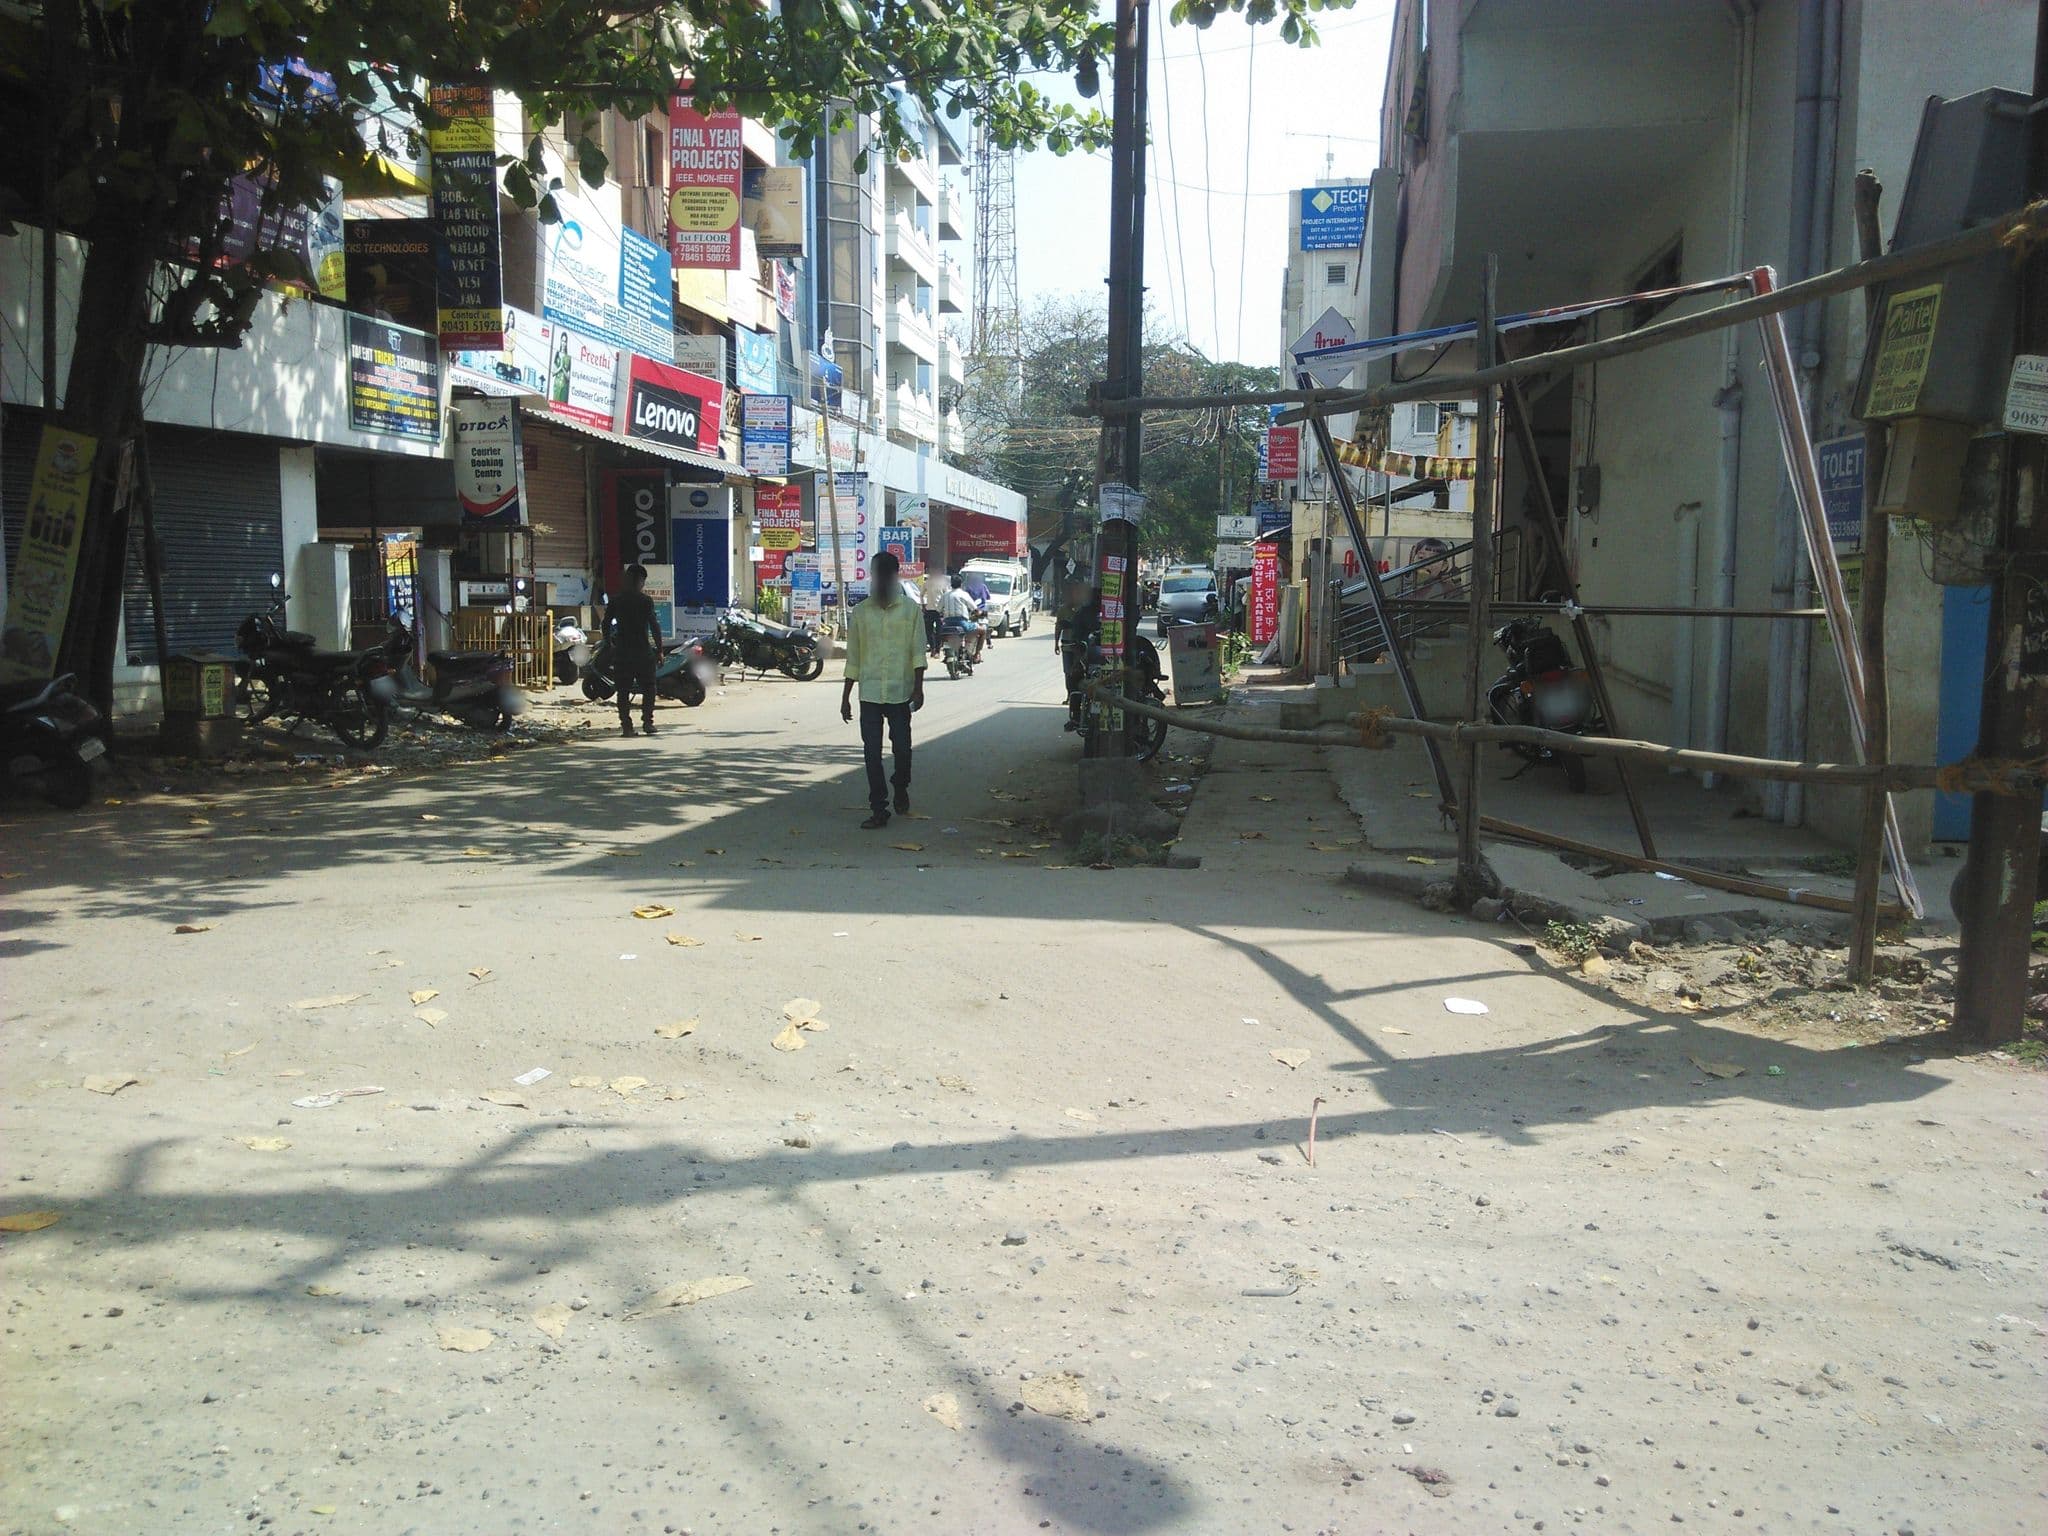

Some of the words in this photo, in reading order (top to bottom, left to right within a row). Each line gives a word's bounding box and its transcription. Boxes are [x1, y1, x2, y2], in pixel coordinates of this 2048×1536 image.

[672, 128, 705, 148] FINAL
[710, 128, 740, 148] YEAR
[672, 150, 740, 170] PROJECTS
[697, 174, 735, 183] NON-IEEE
[1331, 189, 1368, 204] TECH
[1333, 205, 1357, 213] Project
[445, 226, 489, 237] ANDROID
[693, 234, 727, 242] FLOOR
[680, 244, 704, 254] 78451
[680, 254, 704, 262] 78451
[1901, 296, 1934, 333] airtel
[442, 322, 469, 332] 90431
[352, 344, 373, 362] TALENT
[581, 345, 611, 370] Preethi
[2018, 360, 2048, 373] PAR
[459, 422, 497, 432] DTDC
[471, 448, 501, 456] Courier
[471, 458, 504, 467] Booking
[1822, 448, 1862, 480] TOLET
[475, 469, 502, 478] Centre
[757, 509, 778, 518] FINAL
[781, 510, 800, 518] YEAR
[635, 489, 656, 565] novo
[696, 524, 704, 555] KONICA
[883, 531, 909, 541] BAR
[696, 556, 704, 592] MINOLTA
[1255, 560, 1264, 588] MONEY
[1255, 590, 1264, 640] TRANSFER
